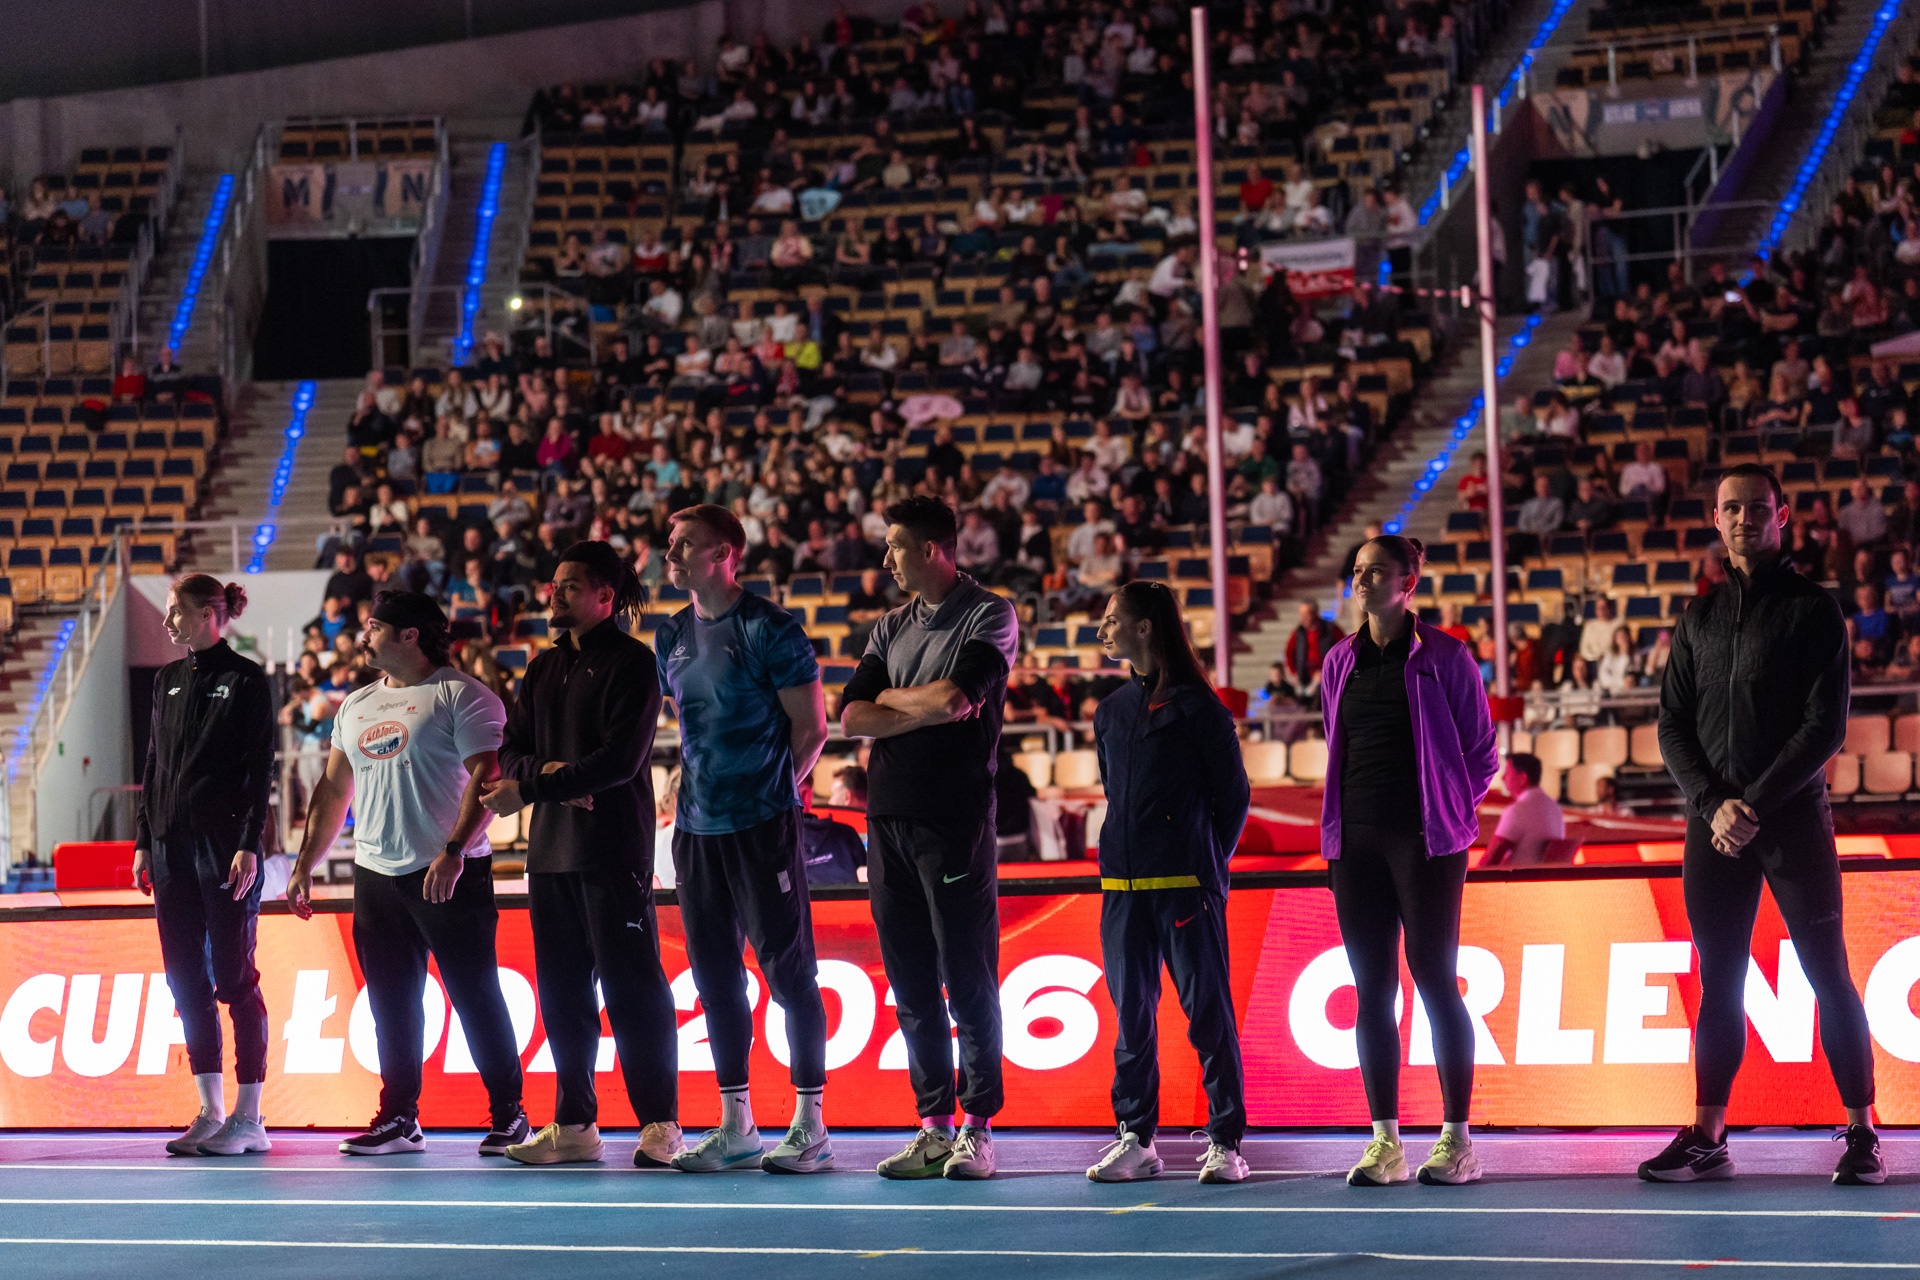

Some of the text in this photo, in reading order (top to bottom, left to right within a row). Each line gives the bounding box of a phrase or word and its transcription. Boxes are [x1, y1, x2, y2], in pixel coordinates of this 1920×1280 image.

[365, 725, 400, 745] Athletic
[377, 737, 399, 755] CLUB
[1288, 937, 1819, 1069] ORLEN
